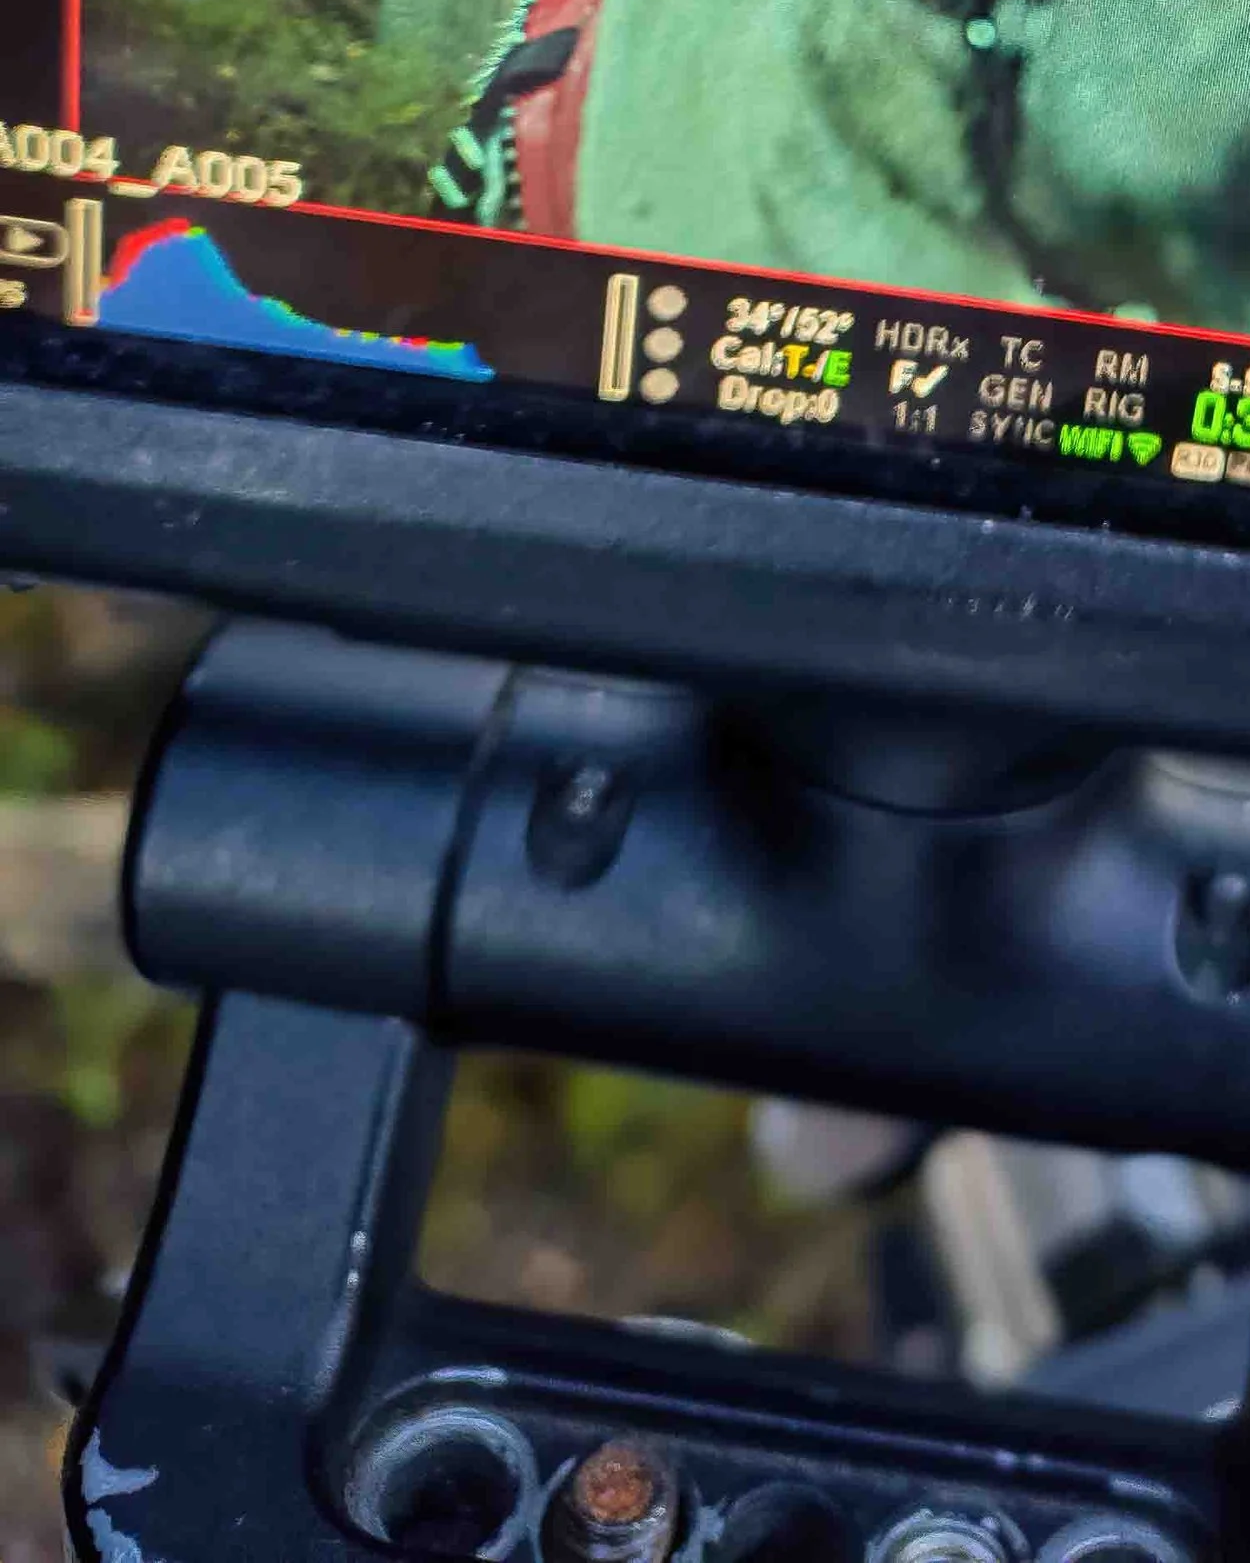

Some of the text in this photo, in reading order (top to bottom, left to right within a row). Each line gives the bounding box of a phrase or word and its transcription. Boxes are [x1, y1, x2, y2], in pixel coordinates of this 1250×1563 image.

[1000, 334, 1045, 375] TC
[979, 373, 1054, 413] GEN
[1083, 386, 1146, 428] RIG
